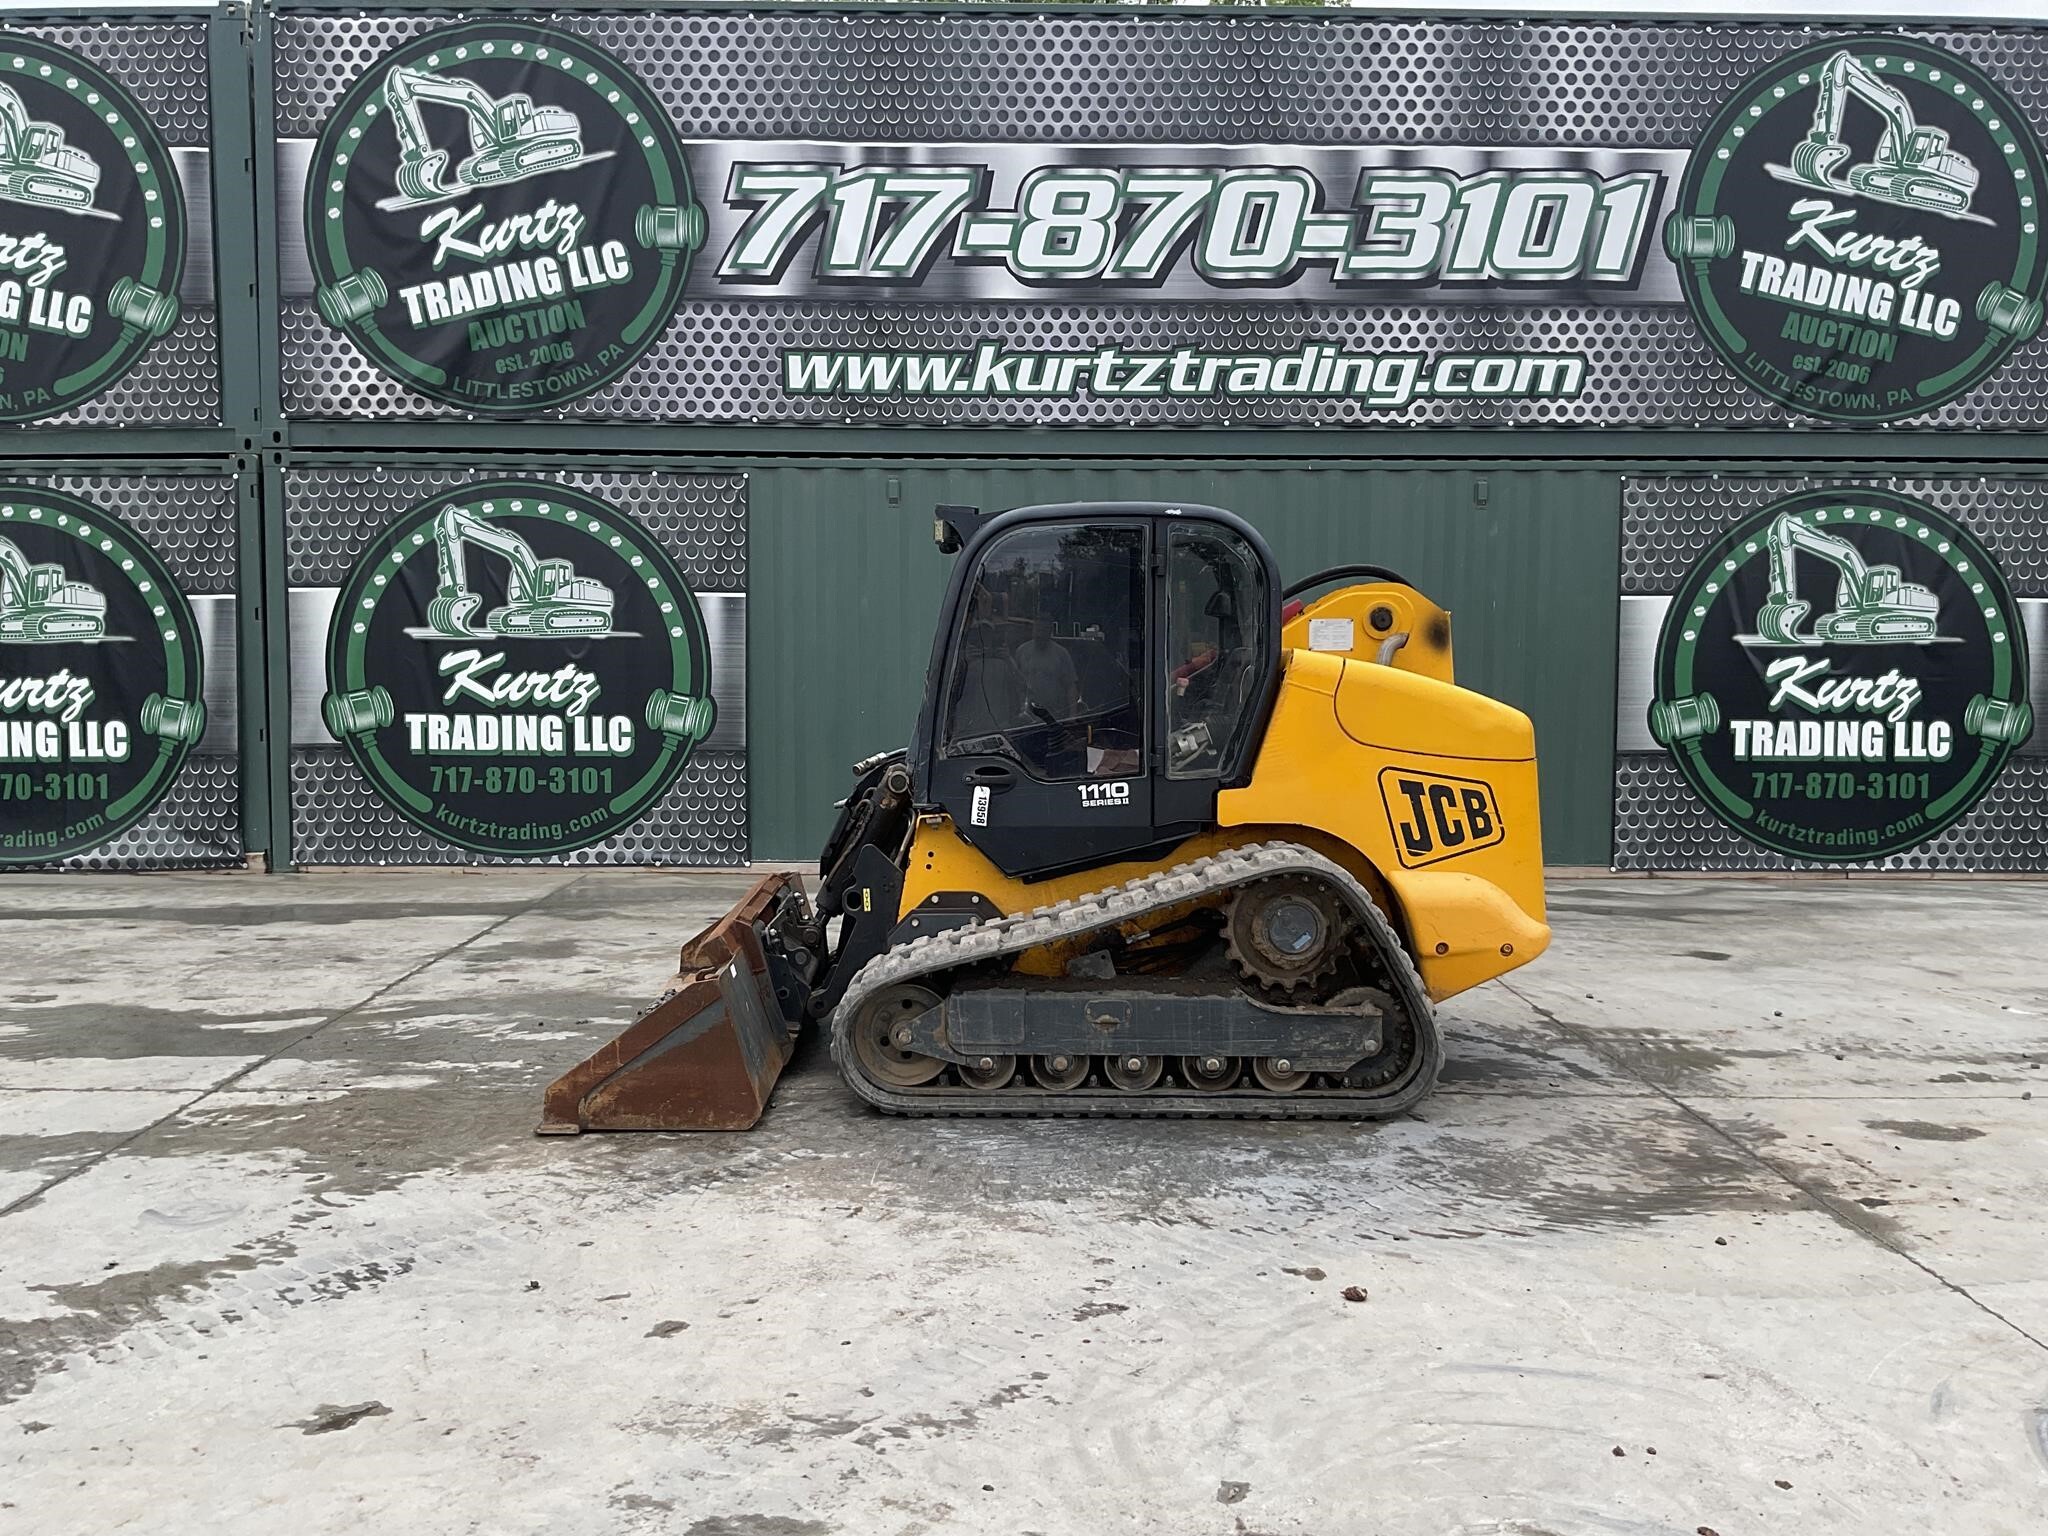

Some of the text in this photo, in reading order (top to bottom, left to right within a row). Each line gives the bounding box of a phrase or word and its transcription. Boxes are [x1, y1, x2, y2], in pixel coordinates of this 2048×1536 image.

[420, 199, 585, 267] Kurtz
[724, 168, 1656, 280] 717-870-3101
[1788, 198, 1941, 289] Kurtz
[400, 239, 631, 326] TRADING LLC
[1739, 249, 1961, 337] TRADING LLC
[28, 286, 93, 334] LLC
[466, 299, 587, 353] AUCTION
[494, 341, 575, 375] est. 2006
[1780, 311, 1898, 363] AUCTION
[452, 342, 625, 400] LITTLESTOWN, PA
[786, 345, 1586, 408] www.kurtztrading.com
[1744, 350, 1914, 410] LITTLESTOWN, PA
[1791, 353, 1871, 385] est. 2006
[23, 387, 51, 406] PA
[0, 668, 94, 723] urtz
[439, 649, 601, 718] Kurtz
[1765, 655, 1923, 722] Kurtz
[69, 720, 128, 758] LLC
[404, 713, 635, 753] TRADING LLC
[1730, 720, 1953, 758] TRADING LLC
[0, 773, 109, 800] 70-3101
[430, 766, 613, 794] 717-870-3101
[1077, 782, 1130, 800] 1110
[1751, 772, 1930, 800] 717-870-3101
[435, 803, 609, 841] kurtztrading.com
[976, 795, 987, 825] 13958
[1082, 799, 1122, 807] SERIES
[1397, 778, 1493, 857] JCB
[2, 813, 105, 848] ading.com
[1755, 809, 1924, 846] kurtztrading.com
